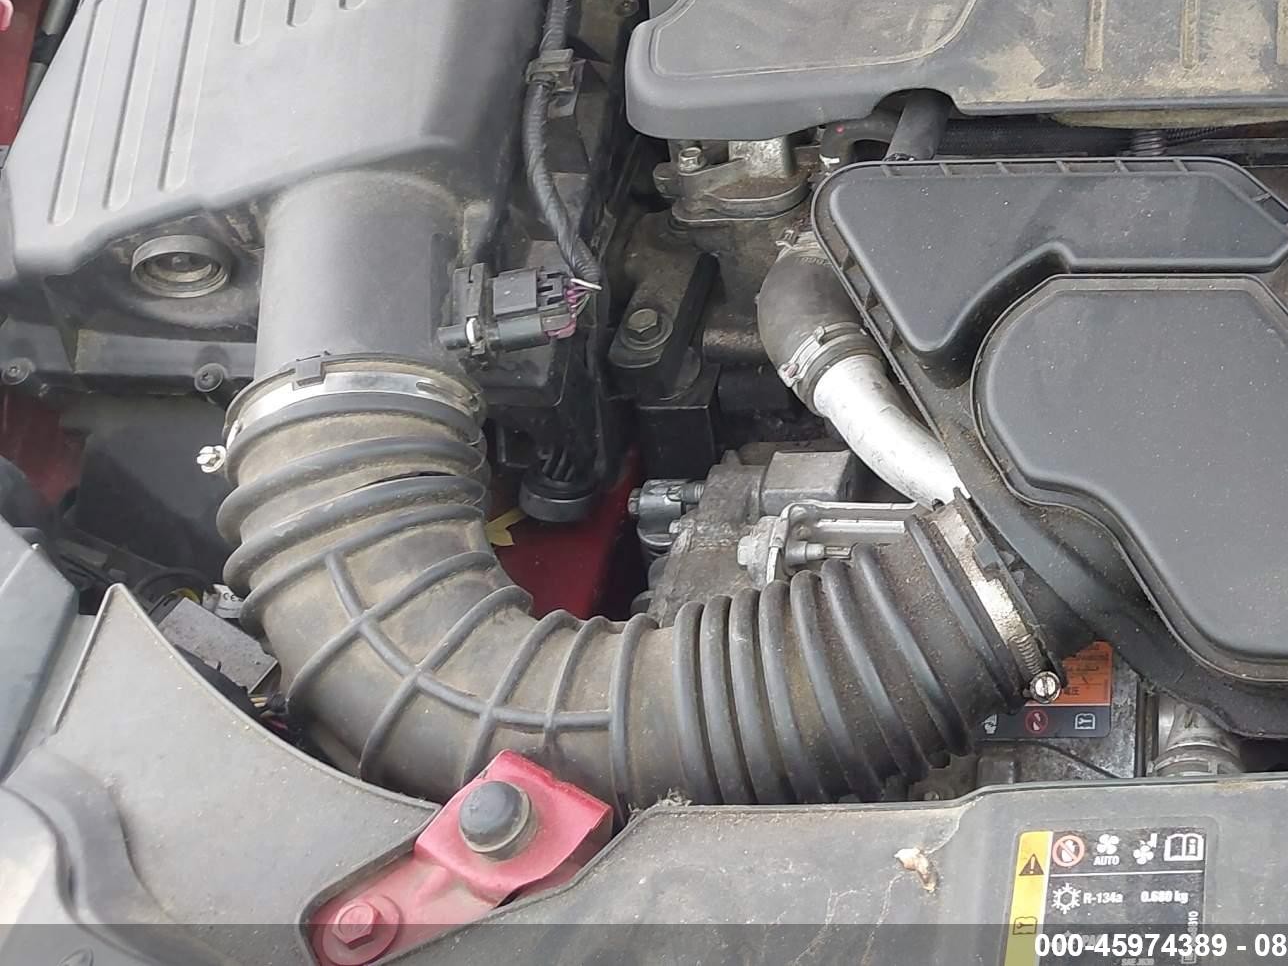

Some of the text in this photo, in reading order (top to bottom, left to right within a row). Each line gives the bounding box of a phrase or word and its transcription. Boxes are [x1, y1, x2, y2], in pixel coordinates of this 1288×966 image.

[1093, 855, 1120, 866] AUTO
[1083, 892, 1123, 904] R-134a
[1174, 891, 1189, 904] kg
